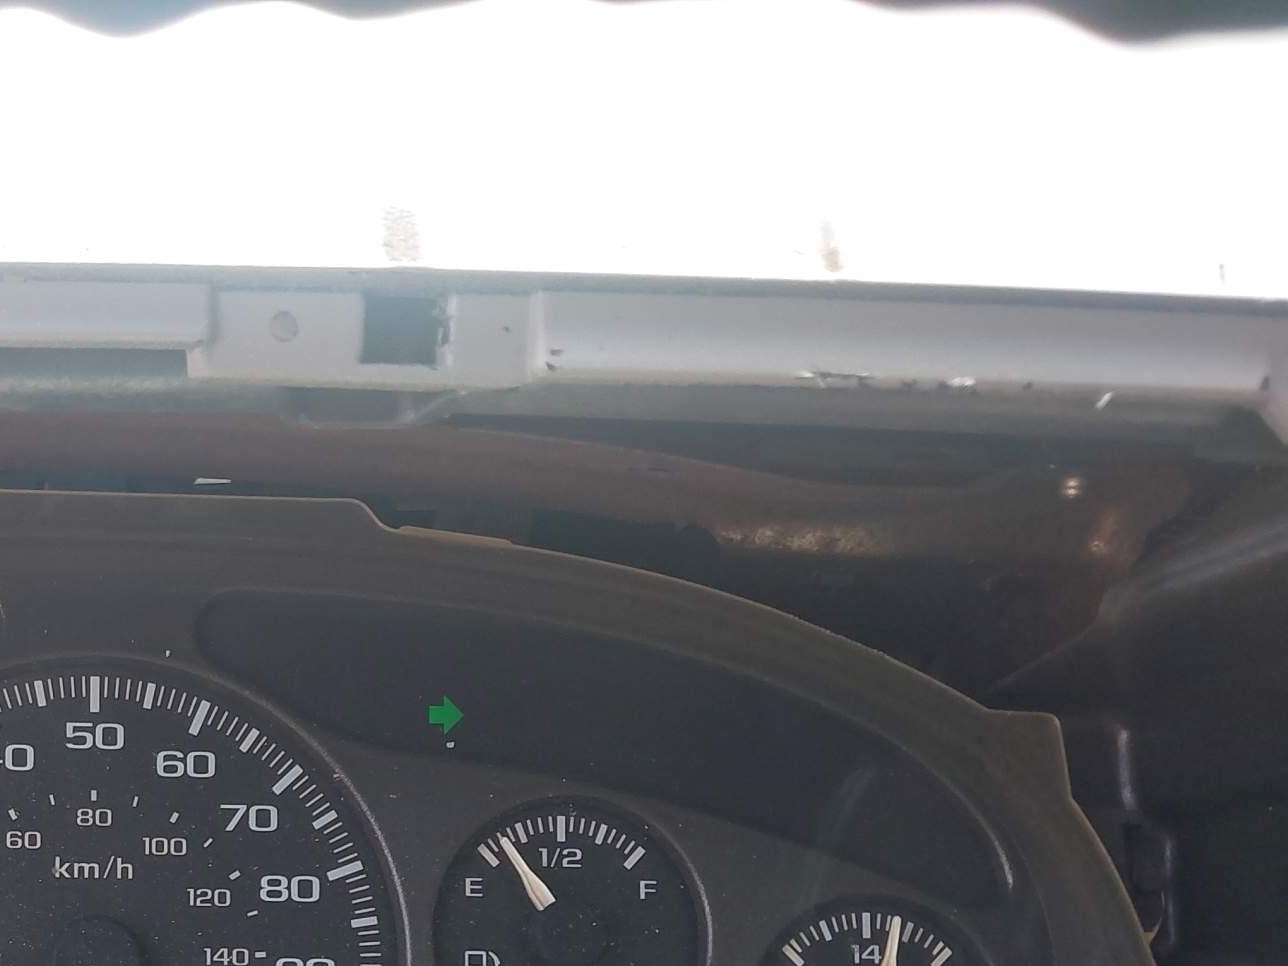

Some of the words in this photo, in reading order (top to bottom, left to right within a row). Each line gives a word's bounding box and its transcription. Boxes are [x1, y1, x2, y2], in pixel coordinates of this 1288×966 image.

[65, 722, 125, 750] 50
[156, 751, 216, 778] 60
[76, 808, 112, 827] 80
[219, 804, 278, 832] 70
[6, 831, 41, 850] 60
[142, 837, 187, 856] 100
[538, 848, 583, 868] 1/2
[53, 856, 134, 880] km/h
[259, 876, 320, 902] 80
[465, 878, 484, 897] E
[639, 880, 657, 899] F
[186, 888, 231, 907] 120
[203, 948, 249, 966] 140
[851, 944, 882, 964] 14
